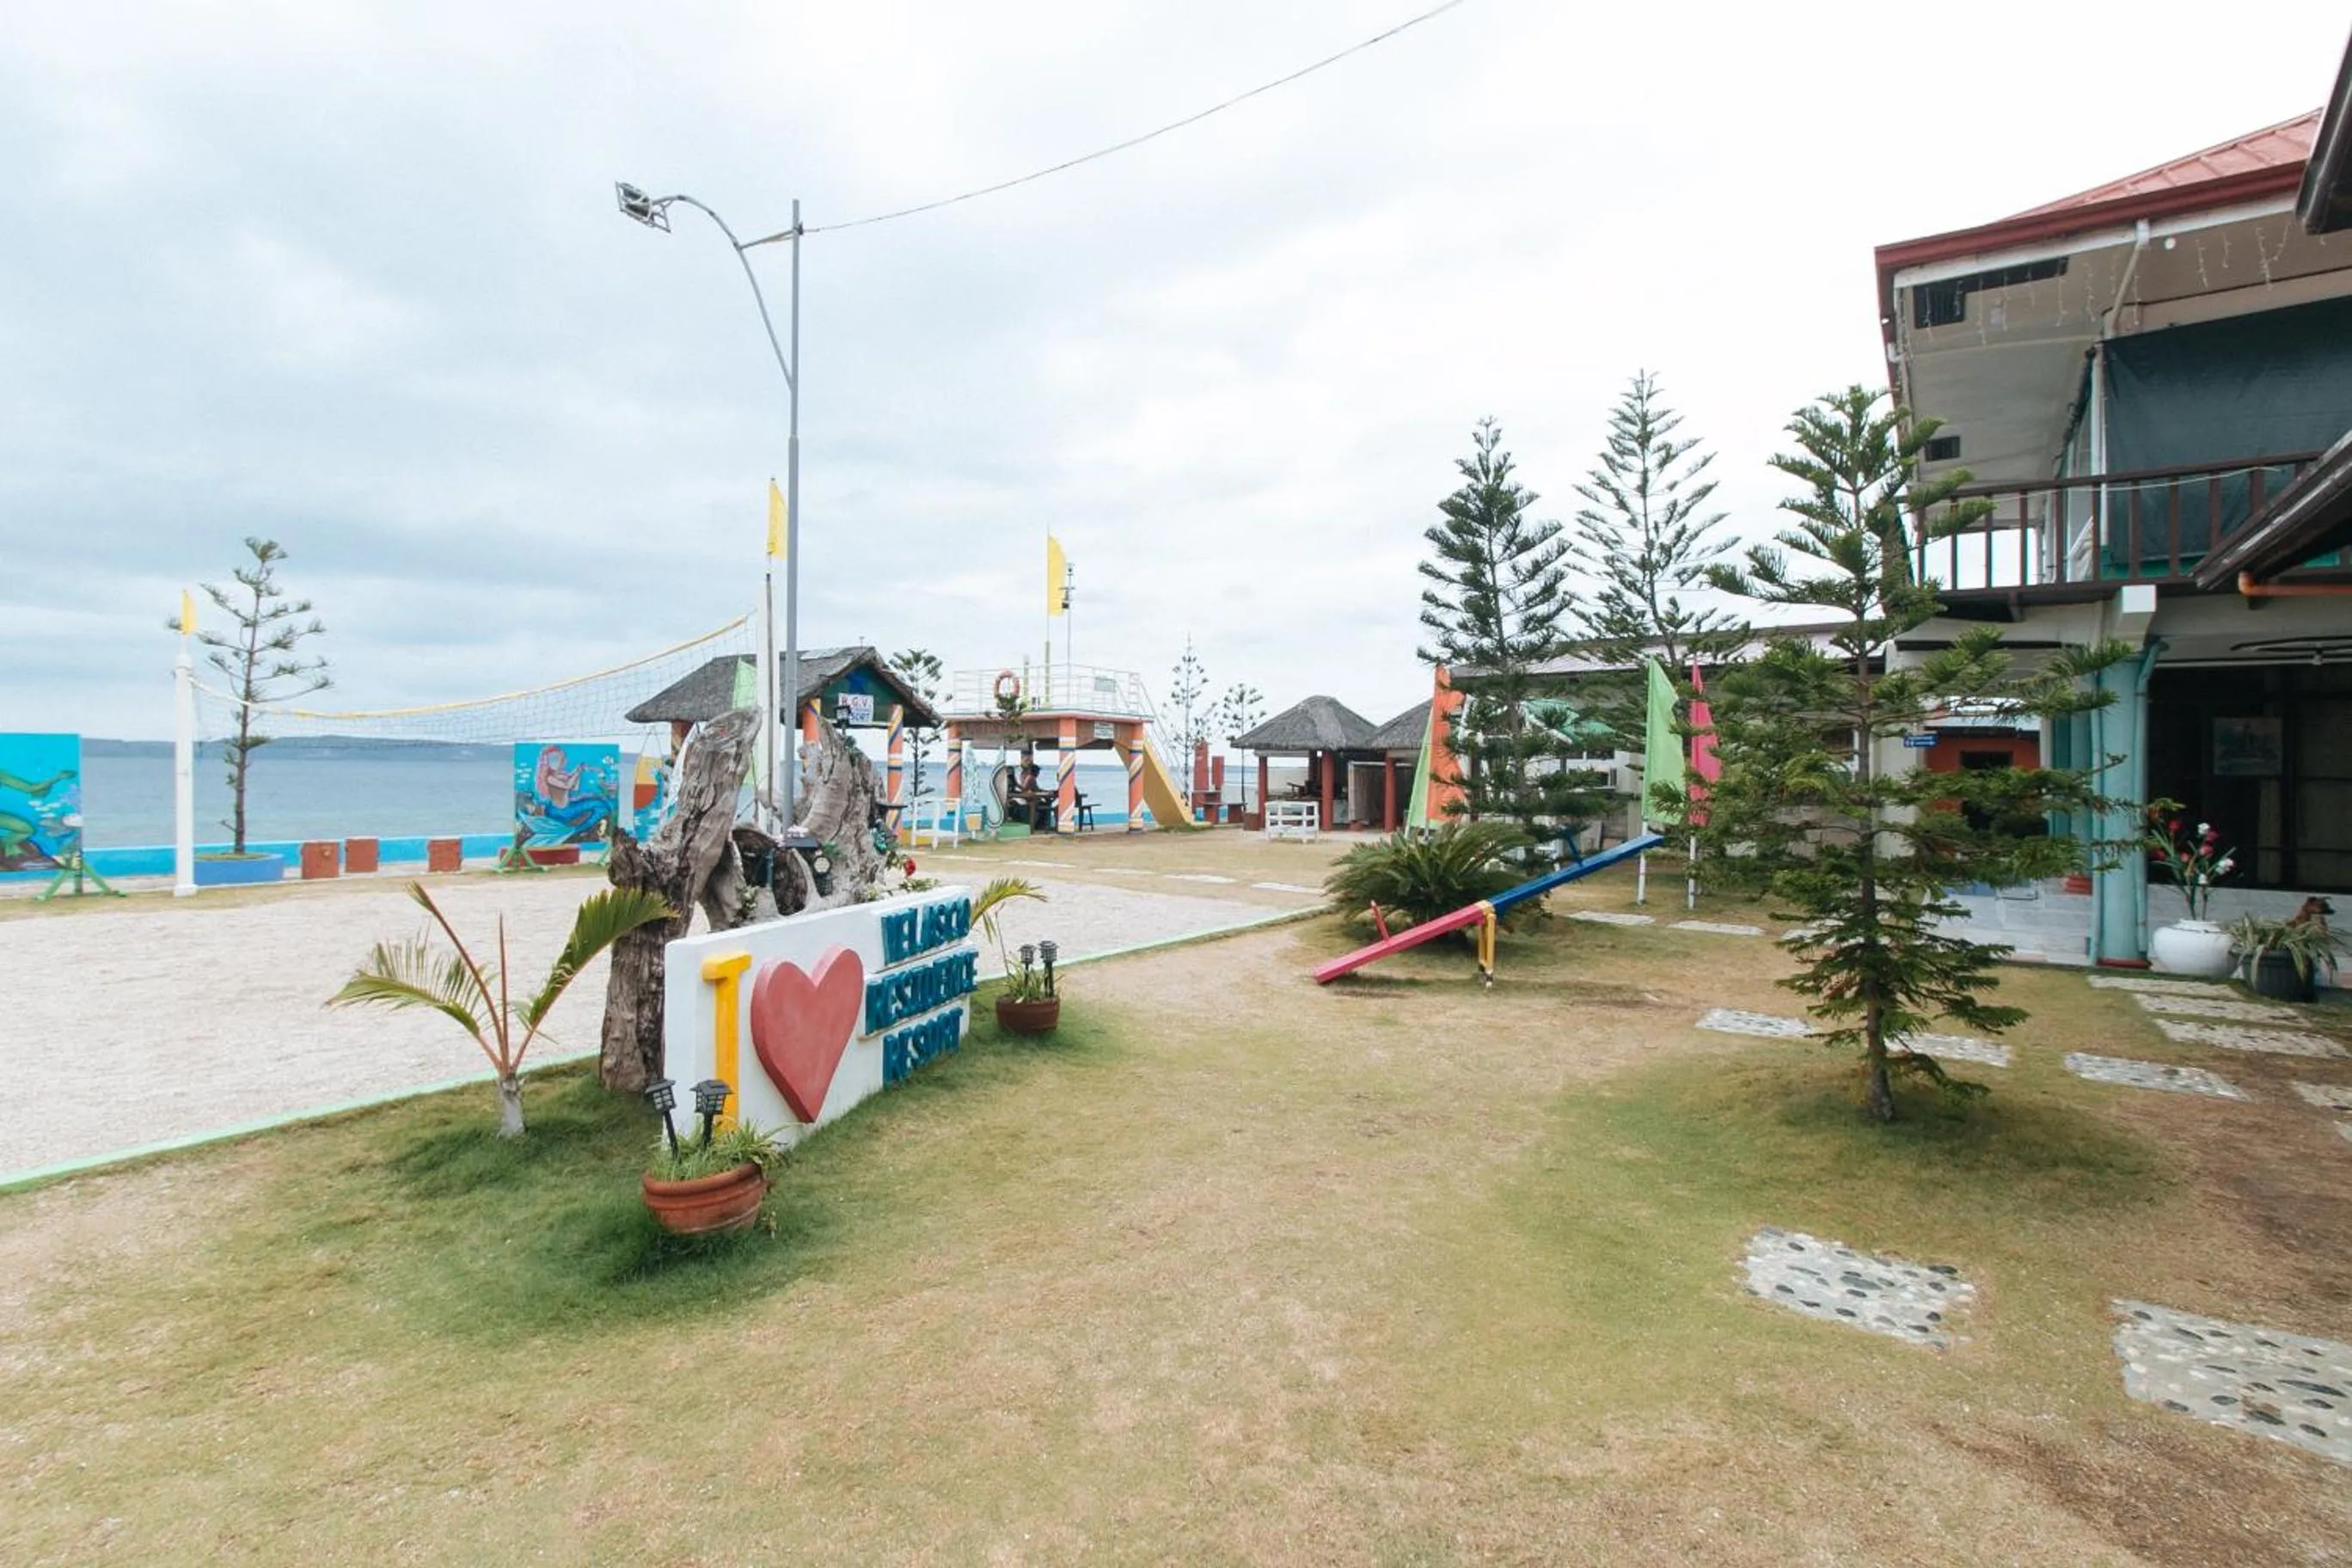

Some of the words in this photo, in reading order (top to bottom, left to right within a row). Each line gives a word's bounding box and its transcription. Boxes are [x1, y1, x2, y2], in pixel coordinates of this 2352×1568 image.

[881, 897, 971, 966] VELASCO
[865, 947, 979, 1035] RESIDENCE
[701, 953, 751, 1136] I
[882, 1007, 963, 1088] RESORT
